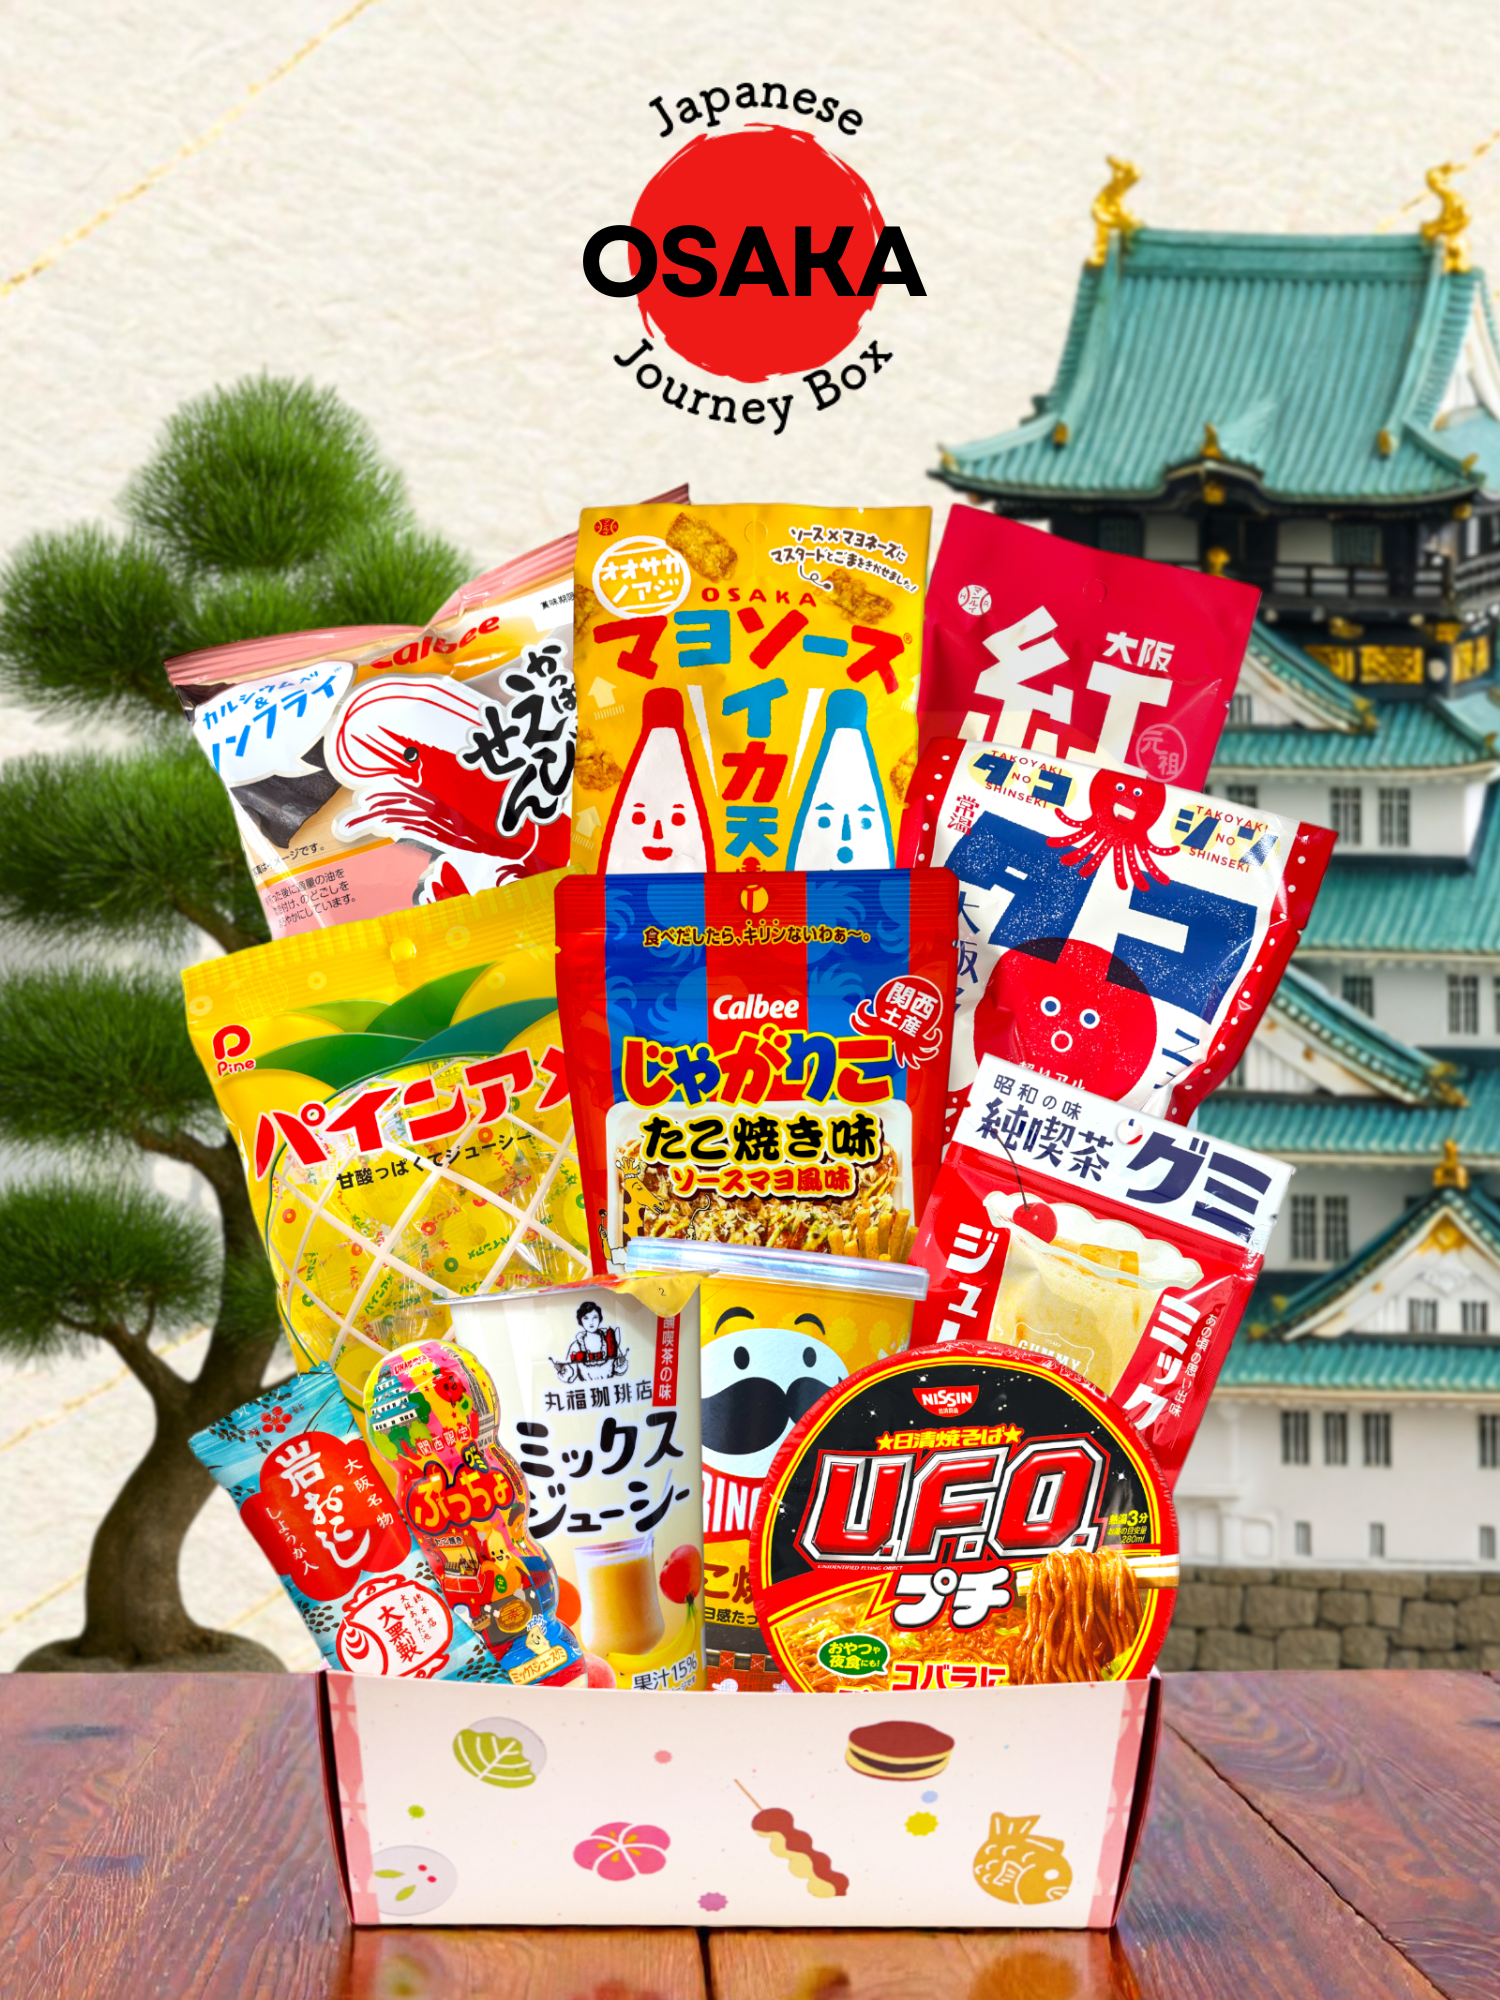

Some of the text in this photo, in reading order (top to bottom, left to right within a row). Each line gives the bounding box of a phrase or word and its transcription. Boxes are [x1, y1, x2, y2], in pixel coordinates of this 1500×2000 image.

[601, 554, 680, 581] オオサカ
[612, 578, 680, 603] ノアジ
[702, 587, 817, 608] OSAKA
[593, 607, 905, 695] マヨソース
[1102, 631, 1175, 673] 大阪
[254, 697, 270, 710] &
[722, 678, 788, 857] イカ天
[991, 750, 1063, 775] TAKOYAKI
[1140, 731, 1181, 776] 元祖
[973, 753, 1073, 807] タコ
[985, 781, 1048, 808] SHINSEKI
[1011, 772, 1032, 784] NO
[1196, 805, 1269, 833] TAKOYAKI
[1215, 832, 1236, 846] NO
[1188, 846, 1251, 873] SHINSEKI
[944, 810, 1258, 1025] タコ
[713, 994, 799, 1021] Calbee
[885, 981, 939, 1020] 関西
[880, 1007, 922, 1037] 土産
[217, 1060, 255, 1076] Pine
[622, 1023, 893, 1109] じゃがりこ
[993, 1074, 1082, 1120] 昭和の味
[642, 1113, 876, 1162] たこ焼き味
[336, 1132, 533, 1191] 甘酸っぱくてジューシー
[673, 1167, 850, 1192] ソースマヨ風味
[976, 1098, 1273, 1243] 純喫茶 グミ
[544, 1379, 653, 1413] 丸福珈琲店
[921, 1390, 973, 1407] NISSIN
[464, 1446, 488, 1469] グミ
[516, 1410, 684, 1478] ミックス
[275, 1440, 370, 1569] 岩おこし
[344, 1458, 394, 1529] 大阪名物
[415, 1465, 508, 1527] ぷっちょ
[801, 1437, 1103, 1562] U.F.O.
[892, 1567, 1011, 1627] プチ
[828, 1642, 881, 1655] おやつや
[829, 1655, 881, 1670] 夜食にも!
[633, 1651, 697, 1690] 果汁15%
